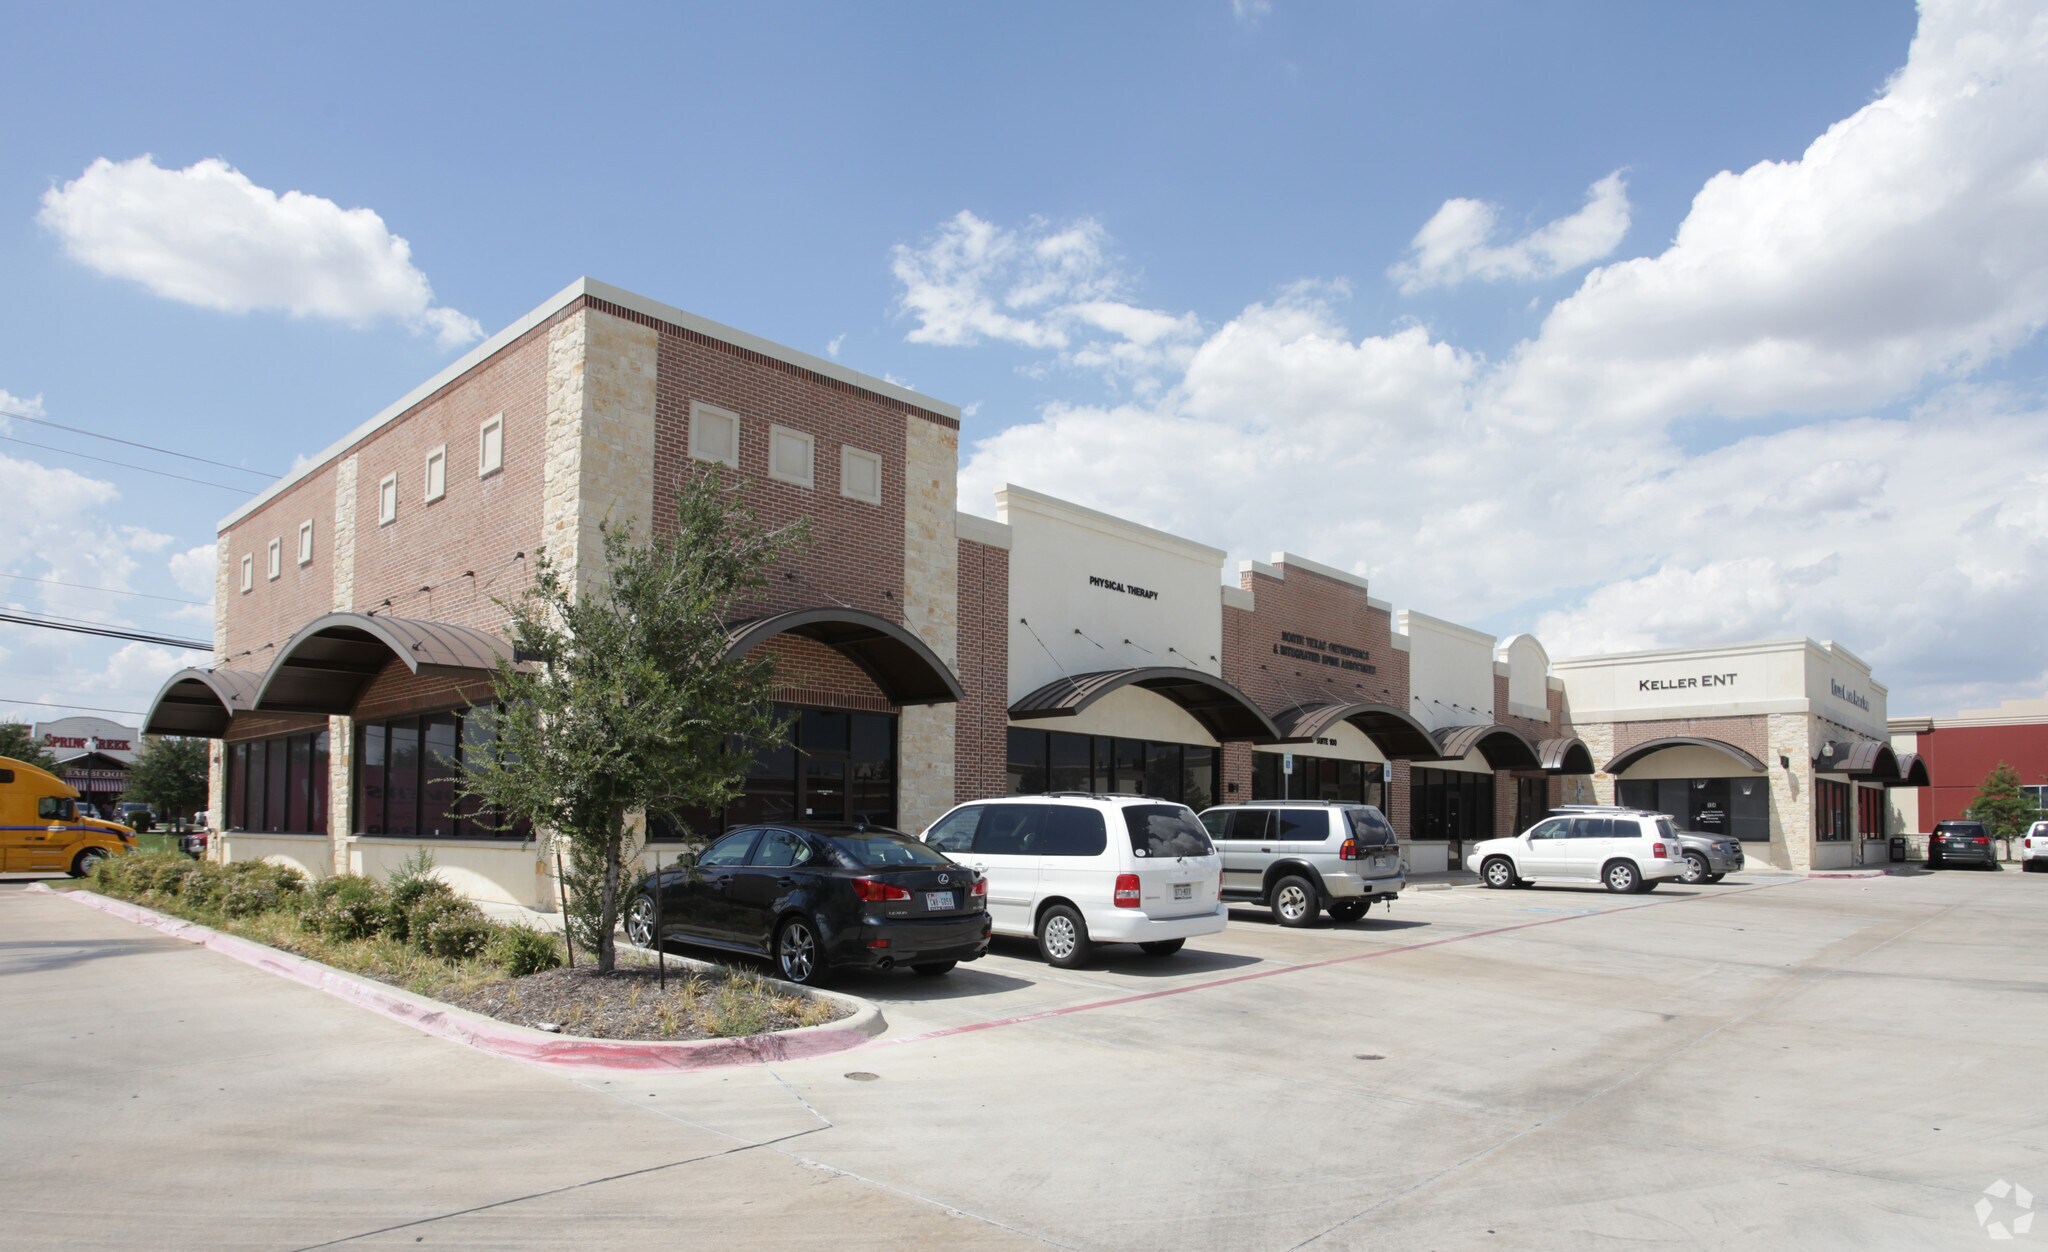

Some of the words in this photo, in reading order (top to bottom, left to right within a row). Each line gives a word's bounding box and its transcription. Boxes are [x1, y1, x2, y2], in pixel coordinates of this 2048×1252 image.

[1089, 575, 1126, 593] PHYSICAL
[1127, 584, 1158, 601] THERAPY
[1281, 631, 1305, 645] NORTH
[1306, 637, 1327, 650] TEXAS
[1639, 678, 1698, 691] KELLER
[1701, 673, 1738, 687] ENT
[1329, 738, 1338, 746] 100
